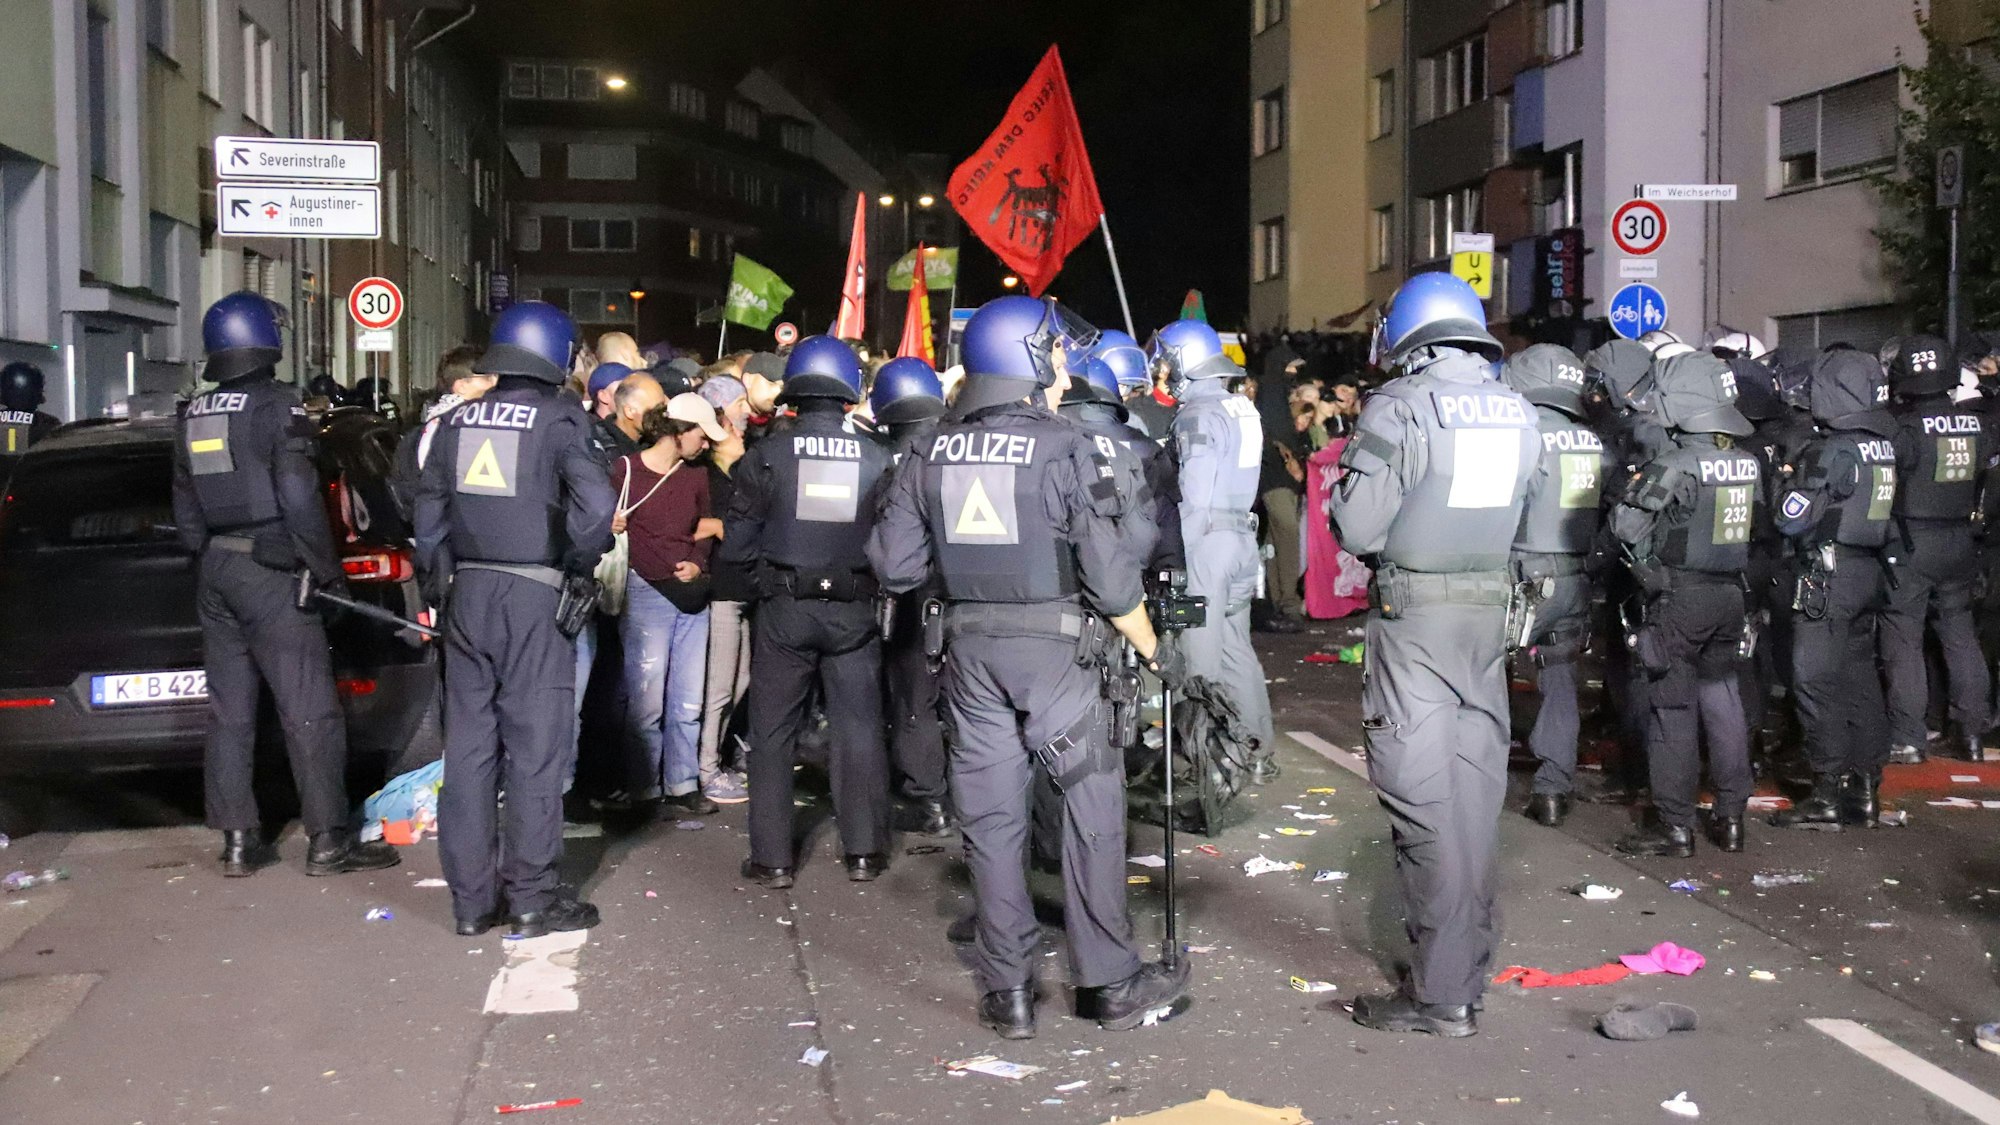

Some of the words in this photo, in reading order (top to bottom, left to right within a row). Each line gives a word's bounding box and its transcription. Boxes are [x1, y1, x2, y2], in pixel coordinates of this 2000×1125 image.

[259, 152, 346, 169] Severinstraße
[1648, 187, 1661, 197] Im
[1667, 187, 1732, 197] Weichserhof
[289, 195, 363, 212] Augustiner-
[289, 215, 323, 228] innen
[1624, 215, 1655, 240] 30
[1469, 253, 1480, 269] U
[361, 293, 391, 315] 30
[1911, 350, 1936, 365] 233
[1558, 364, 1584, 385] 232
[185, 393, 249, 417] POLIZEI
[1440, 395, 1527, 424] POLIZEI
[0, 411, 34, 425] OLIZEI
[450, 401, 538, 429] POLIZEI
[1922, 416, 1981, 433] POLIZEI
[794, 436, 861, 458] POLIZEI
[930, 433, 1036, 464] POLIZEI
[1948, 438, 1967, 451] TH
[1572, 456, 1591, 473] TH
[1946, 453, 1970, 466] 233
[1570, 474, 1595, 489] 232
[1881, 468, 1893, 483] TH
[1728, 488, 1747, 505] TH
[1877, 485, 1893, 500] 232
[1724, 507, 1748, 523] 232
[116, 678, 130, 699] K
[147, 677, 162, 698] B
